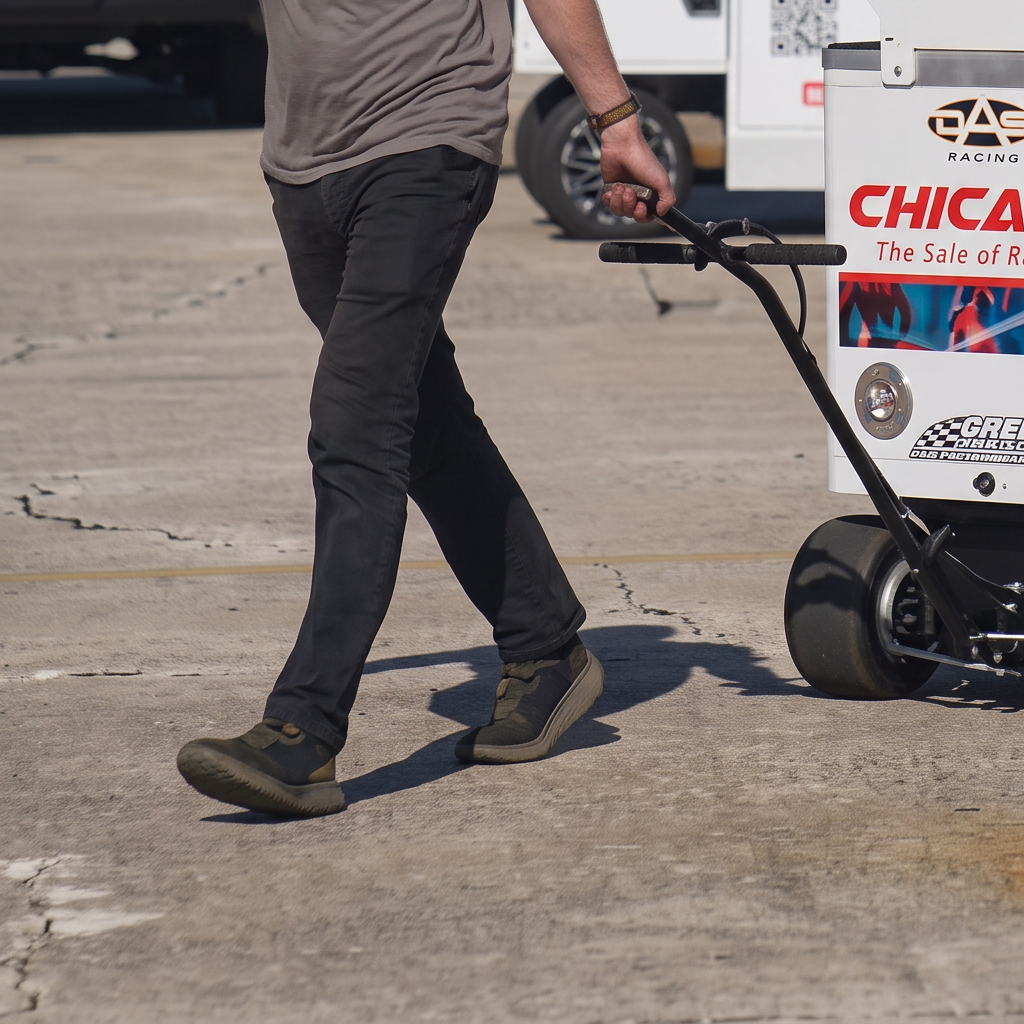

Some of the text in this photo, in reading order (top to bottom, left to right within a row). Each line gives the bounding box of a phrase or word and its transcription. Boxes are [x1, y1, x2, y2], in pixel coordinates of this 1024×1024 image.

[947, 152, 1020, 164] RACING
[876, 240, 914, 263] The
[923, 242, 968, 265] Sale
[977, 243, 1002, 266] of
